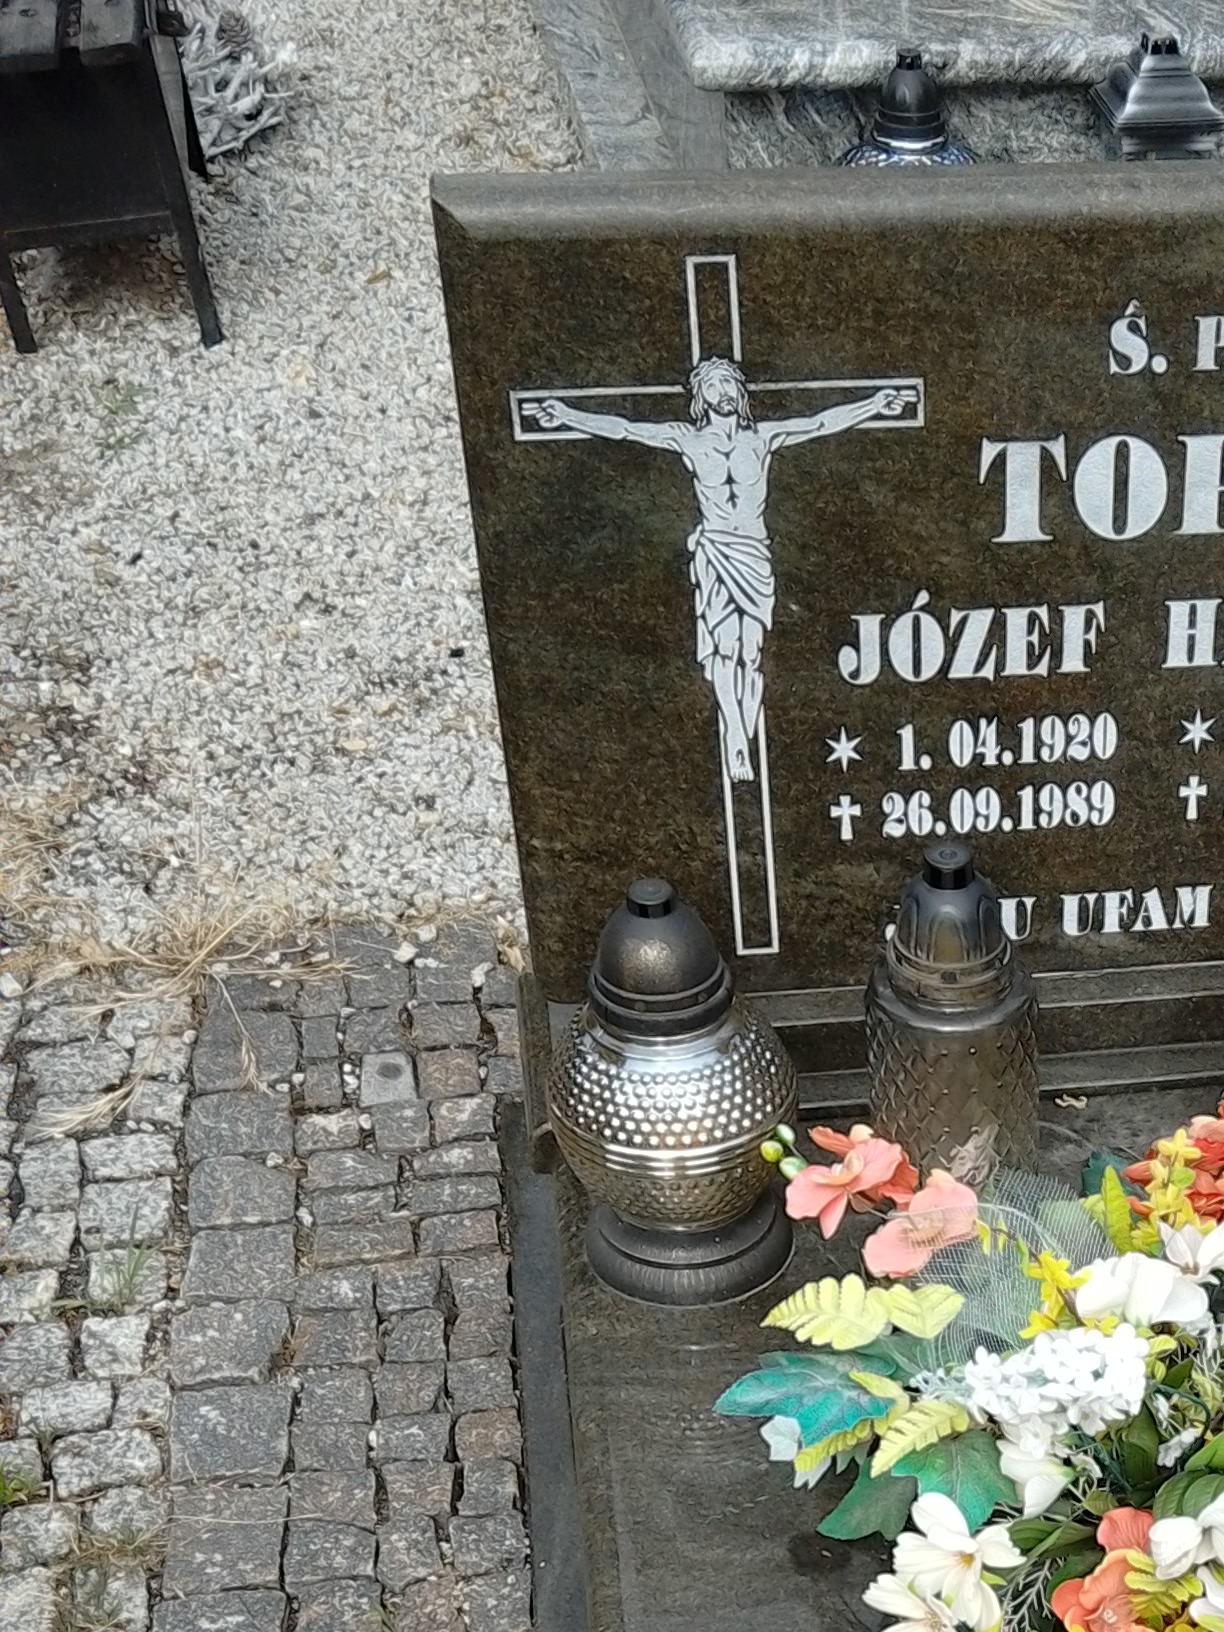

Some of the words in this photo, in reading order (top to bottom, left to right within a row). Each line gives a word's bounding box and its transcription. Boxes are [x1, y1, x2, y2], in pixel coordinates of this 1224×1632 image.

[1109, 298, 1169, 375] Ś.
[838, 588, 1106, 685] JÓZEF
[882, 780, 1116, 838] 26.09.1989
[1059, 883, 1214, 936] UFAM
